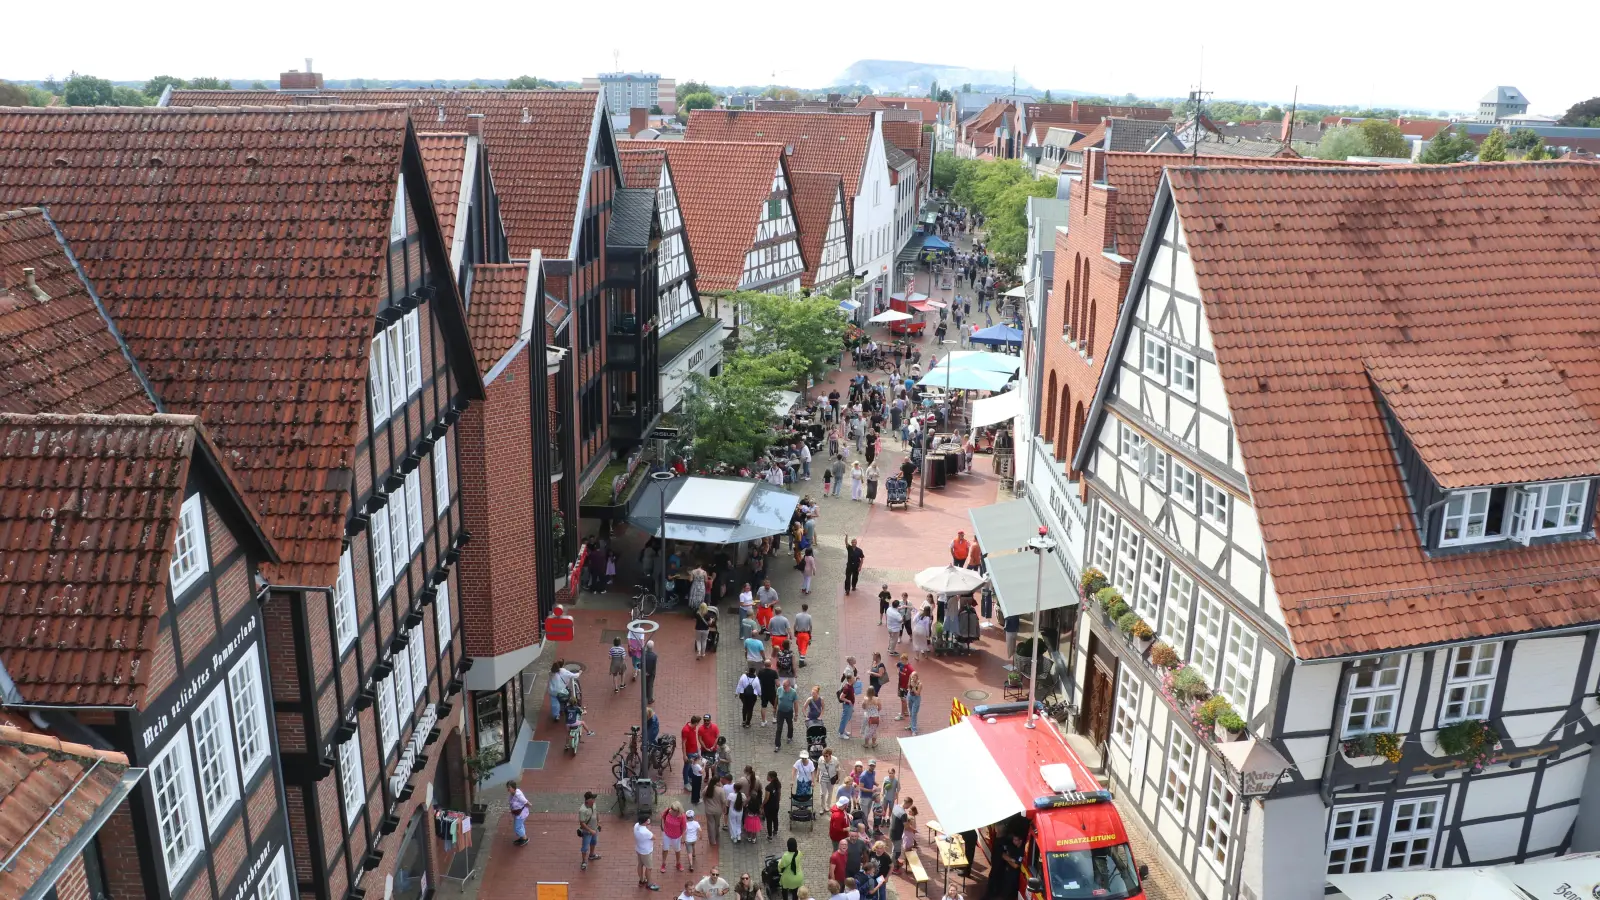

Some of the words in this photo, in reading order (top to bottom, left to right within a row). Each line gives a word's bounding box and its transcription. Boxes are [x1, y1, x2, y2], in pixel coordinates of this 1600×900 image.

[142, 714, 169, 749] Mein
[171, 668, 210, 719] geliebtes
[212, 615, 256, 672] Pommerland
[1056, 834, 1116, 846] EINSATZLEITUNG
